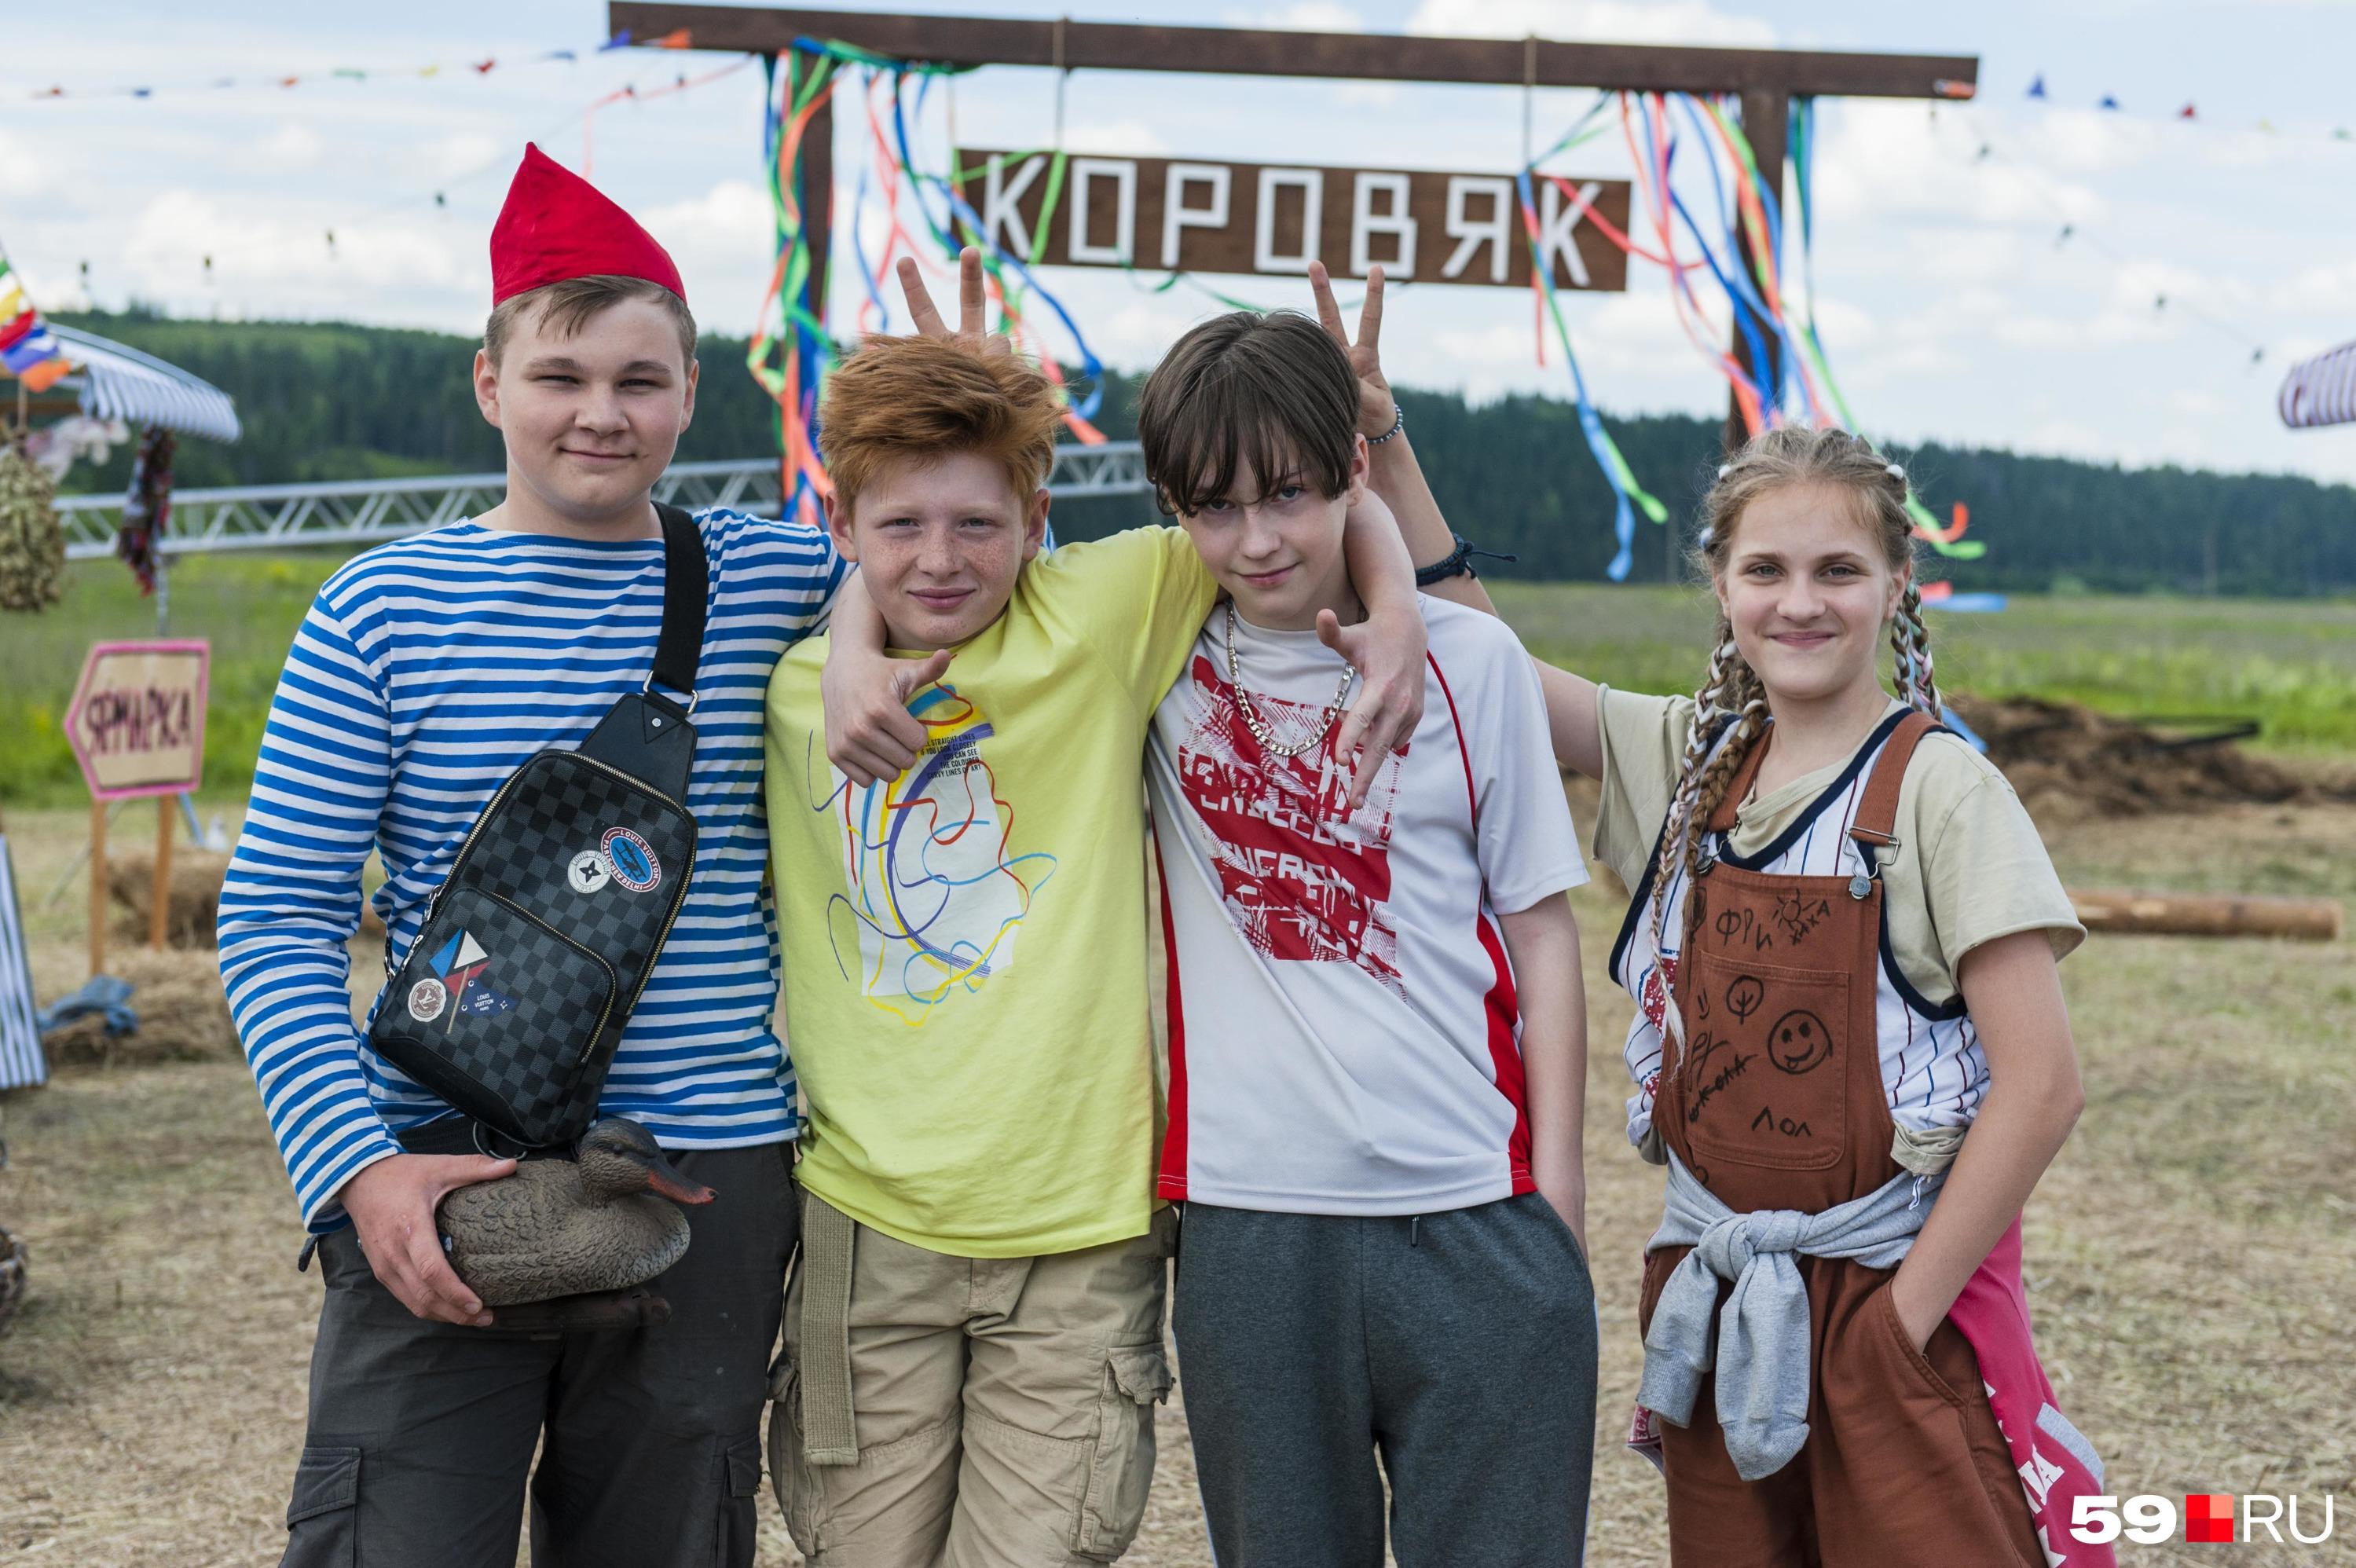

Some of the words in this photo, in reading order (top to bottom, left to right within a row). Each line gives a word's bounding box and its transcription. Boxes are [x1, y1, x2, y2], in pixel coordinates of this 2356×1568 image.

[984, 153, 1603, 287] КОРОВЯК
[930, 735, 957, 746] STRAIGHT
[926, 746, 936, 755] YOU
[952, 741, 976, 751] CLOSELY
[954, 750, 966, 759] CAN
[967, 748, 977, 757] SEE
[940, 760, 951, 769] THE
[945, 768, 962, 777] LINES
[620, 830, 643, 845] LOUIS
[643, 845, 659, 879] VUITTON
[621, 877, 643, 890] DELHI
[474, 998, 494, 1008] VUITTON
